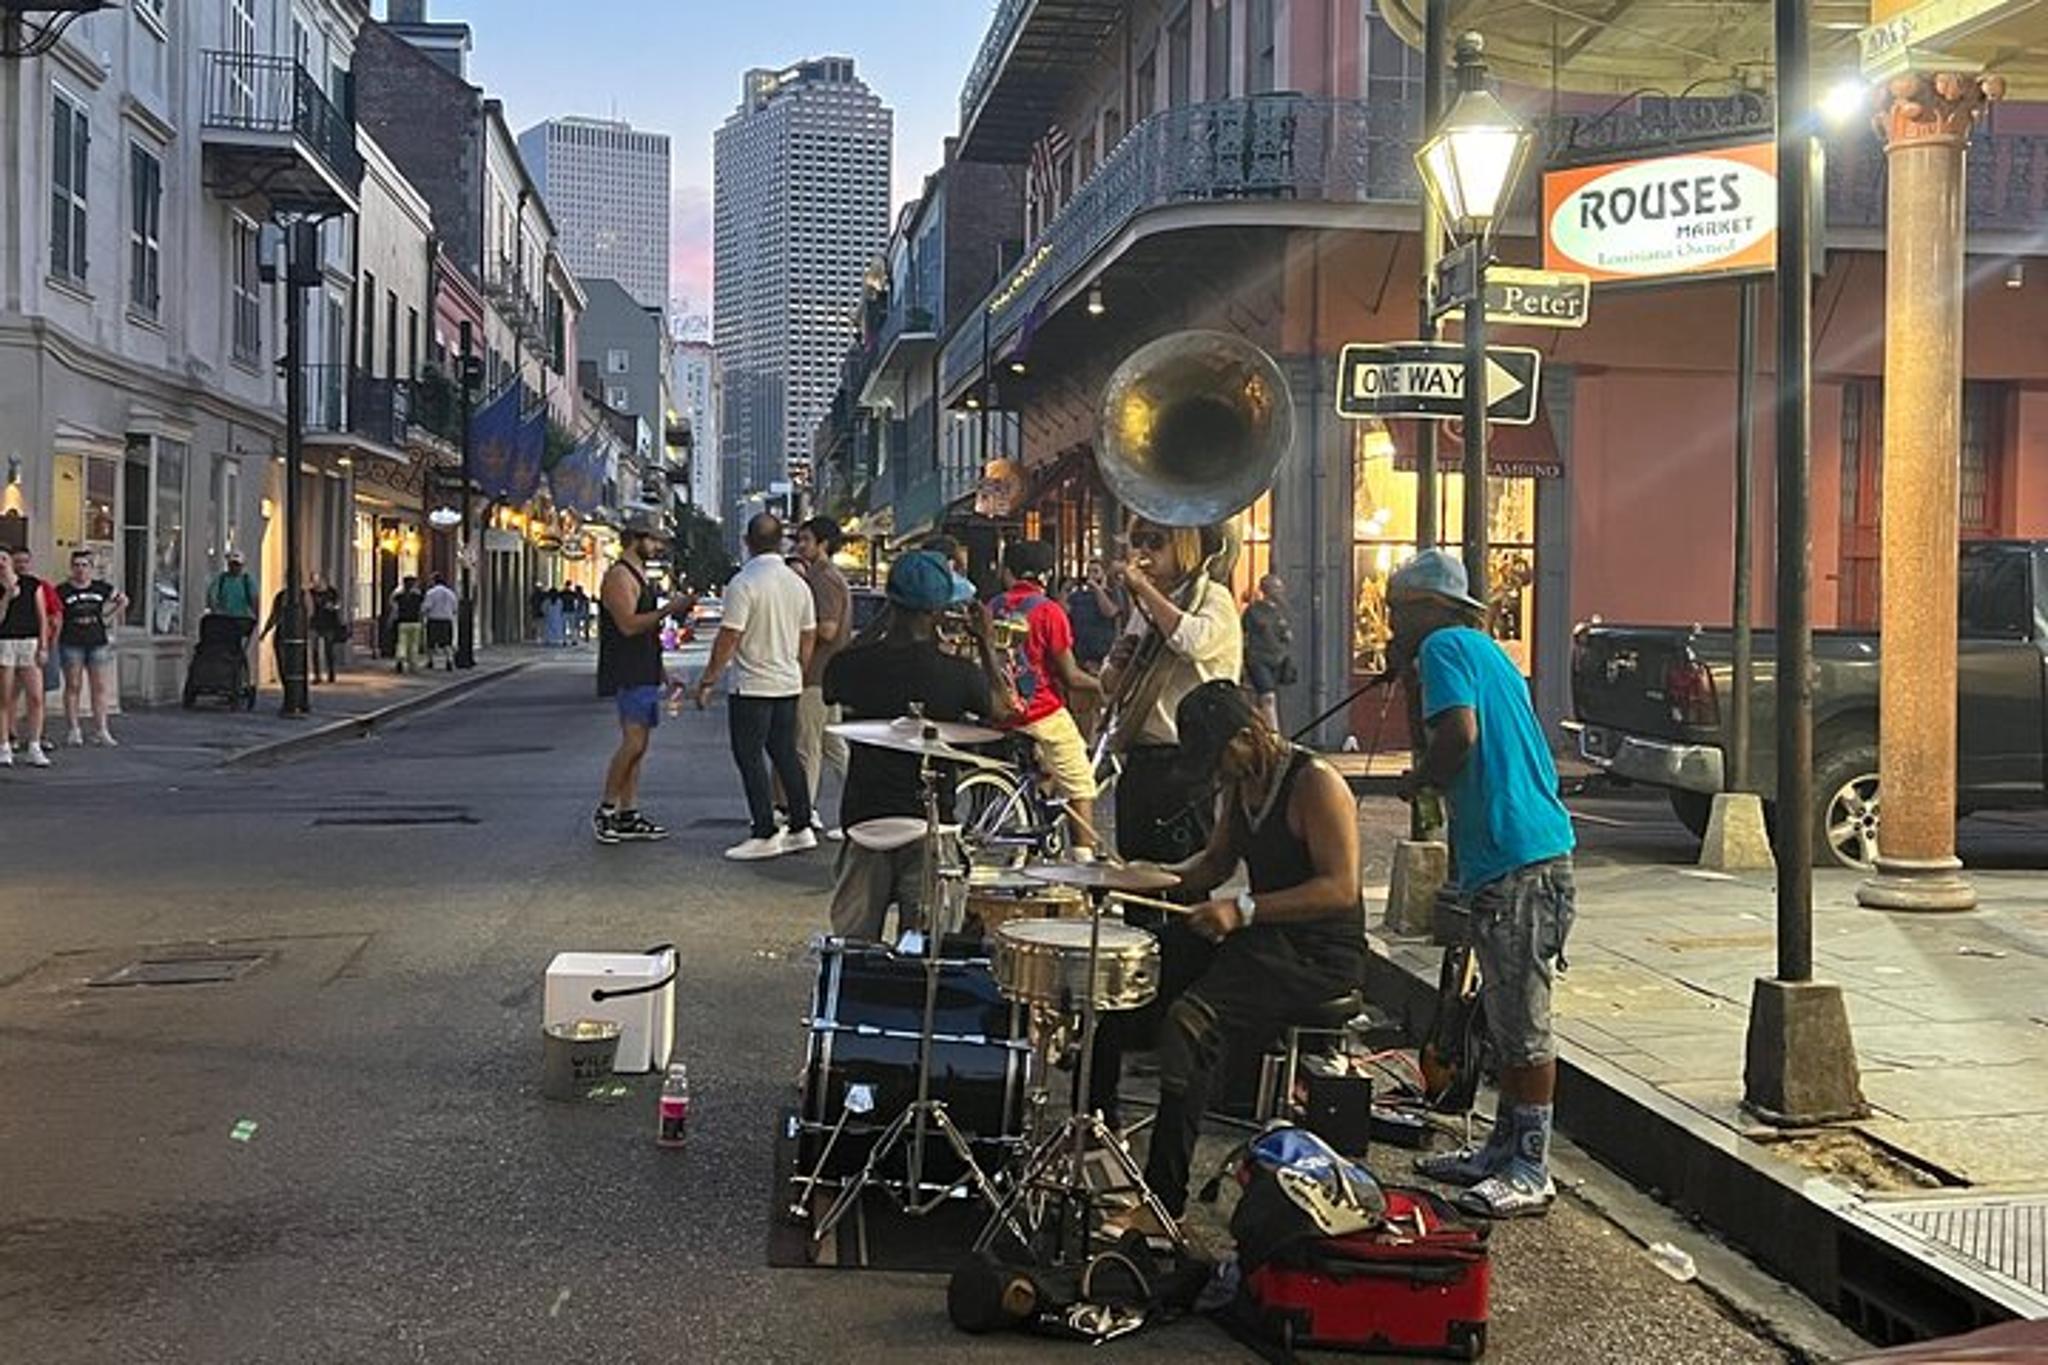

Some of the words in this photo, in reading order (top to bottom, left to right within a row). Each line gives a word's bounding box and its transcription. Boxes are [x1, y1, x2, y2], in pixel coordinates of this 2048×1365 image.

[1579, 172, 1742, 231] ROUSES
[1675, 215, 1755, 240] MARKET
[1502, 286, 1581, 317] Peter
[1362, 367, 1400, 394] ONE
[1406, 365, 1466, 394] WAY
